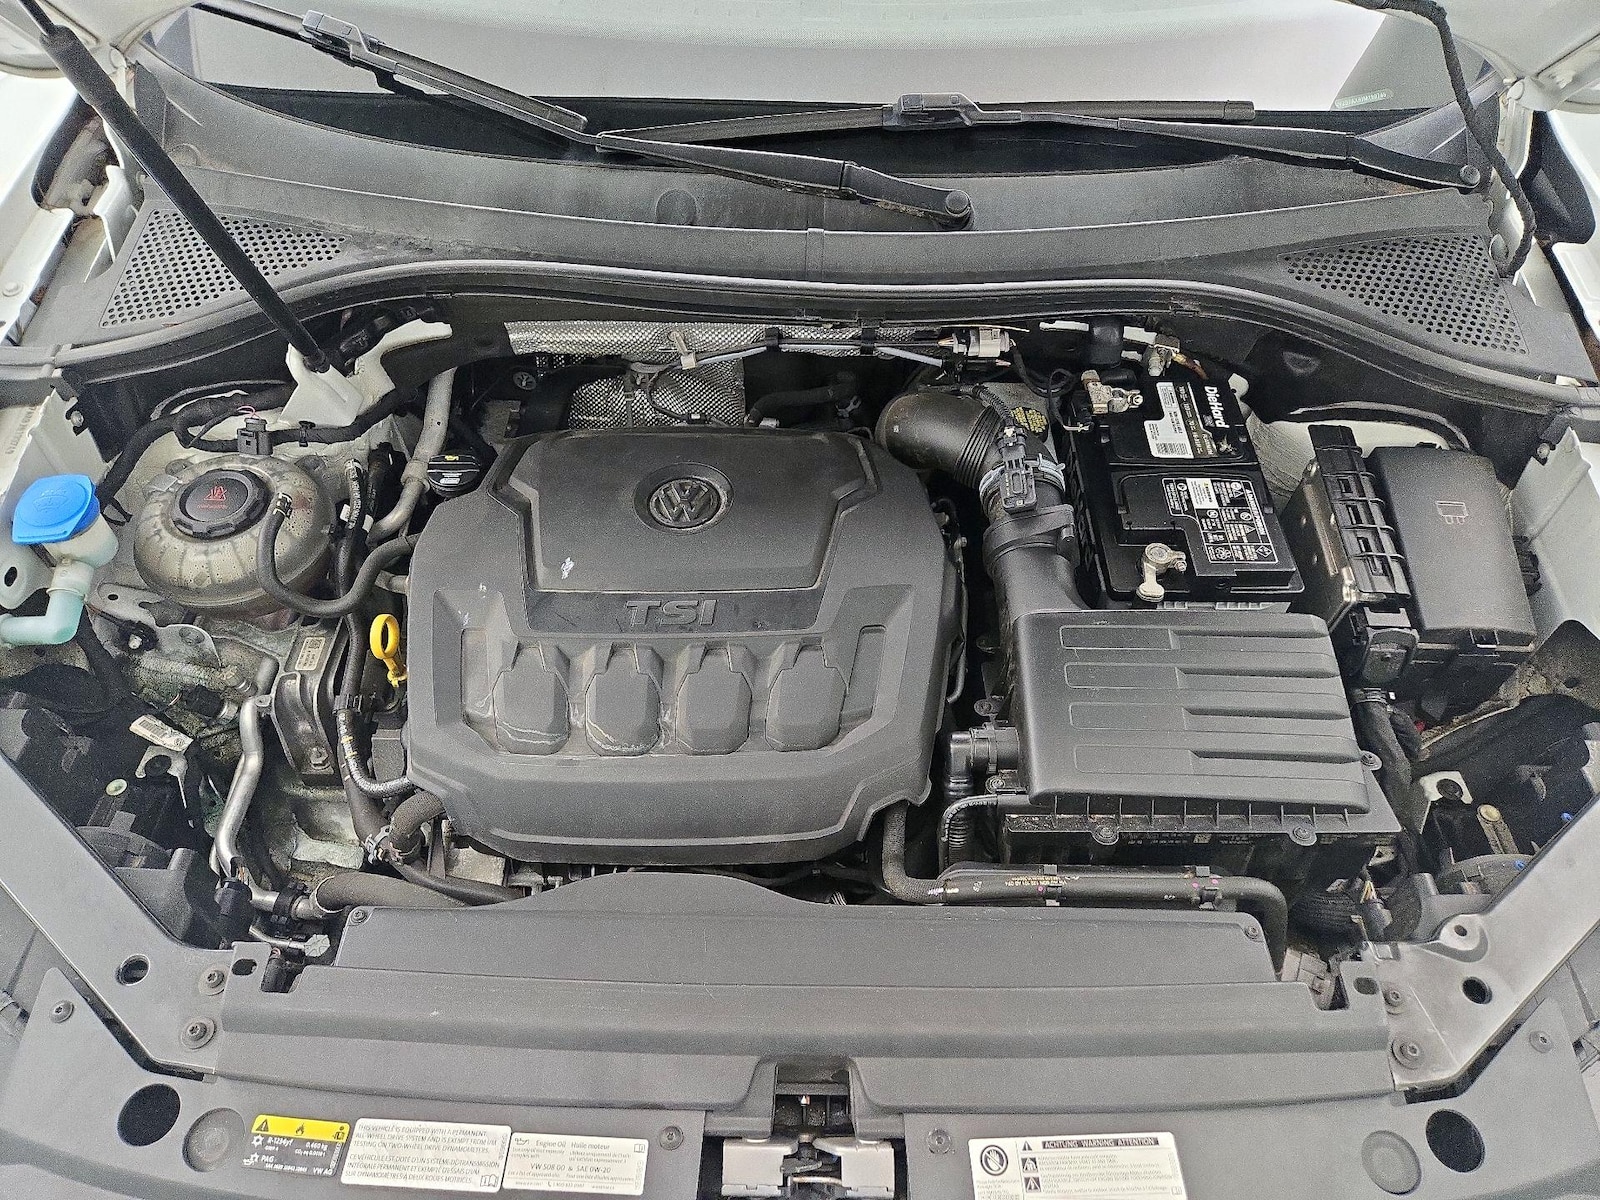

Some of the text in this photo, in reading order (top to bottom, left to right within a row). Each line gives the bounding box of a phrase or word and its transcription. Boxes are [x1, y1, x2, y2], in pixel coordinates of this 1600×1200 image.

[1204, 386, 1230, 429] DieHard
[626, 600, 718, 626] TSI
[535, 1139, 557, 1148] Engine
[571, 1141, 588, 1149] Huile
[1044, 1136, 1155, 1149] ACHTUNG WARNING ATTENTION
[261, 1155, 275, 1163] PAG
[312, 1166, 324, 1175] VW
[323, 1168, 333, 1176] AG
[530, 1162, 542, 1170] VW
[590, 1165, 611, 1173] 0W-20
